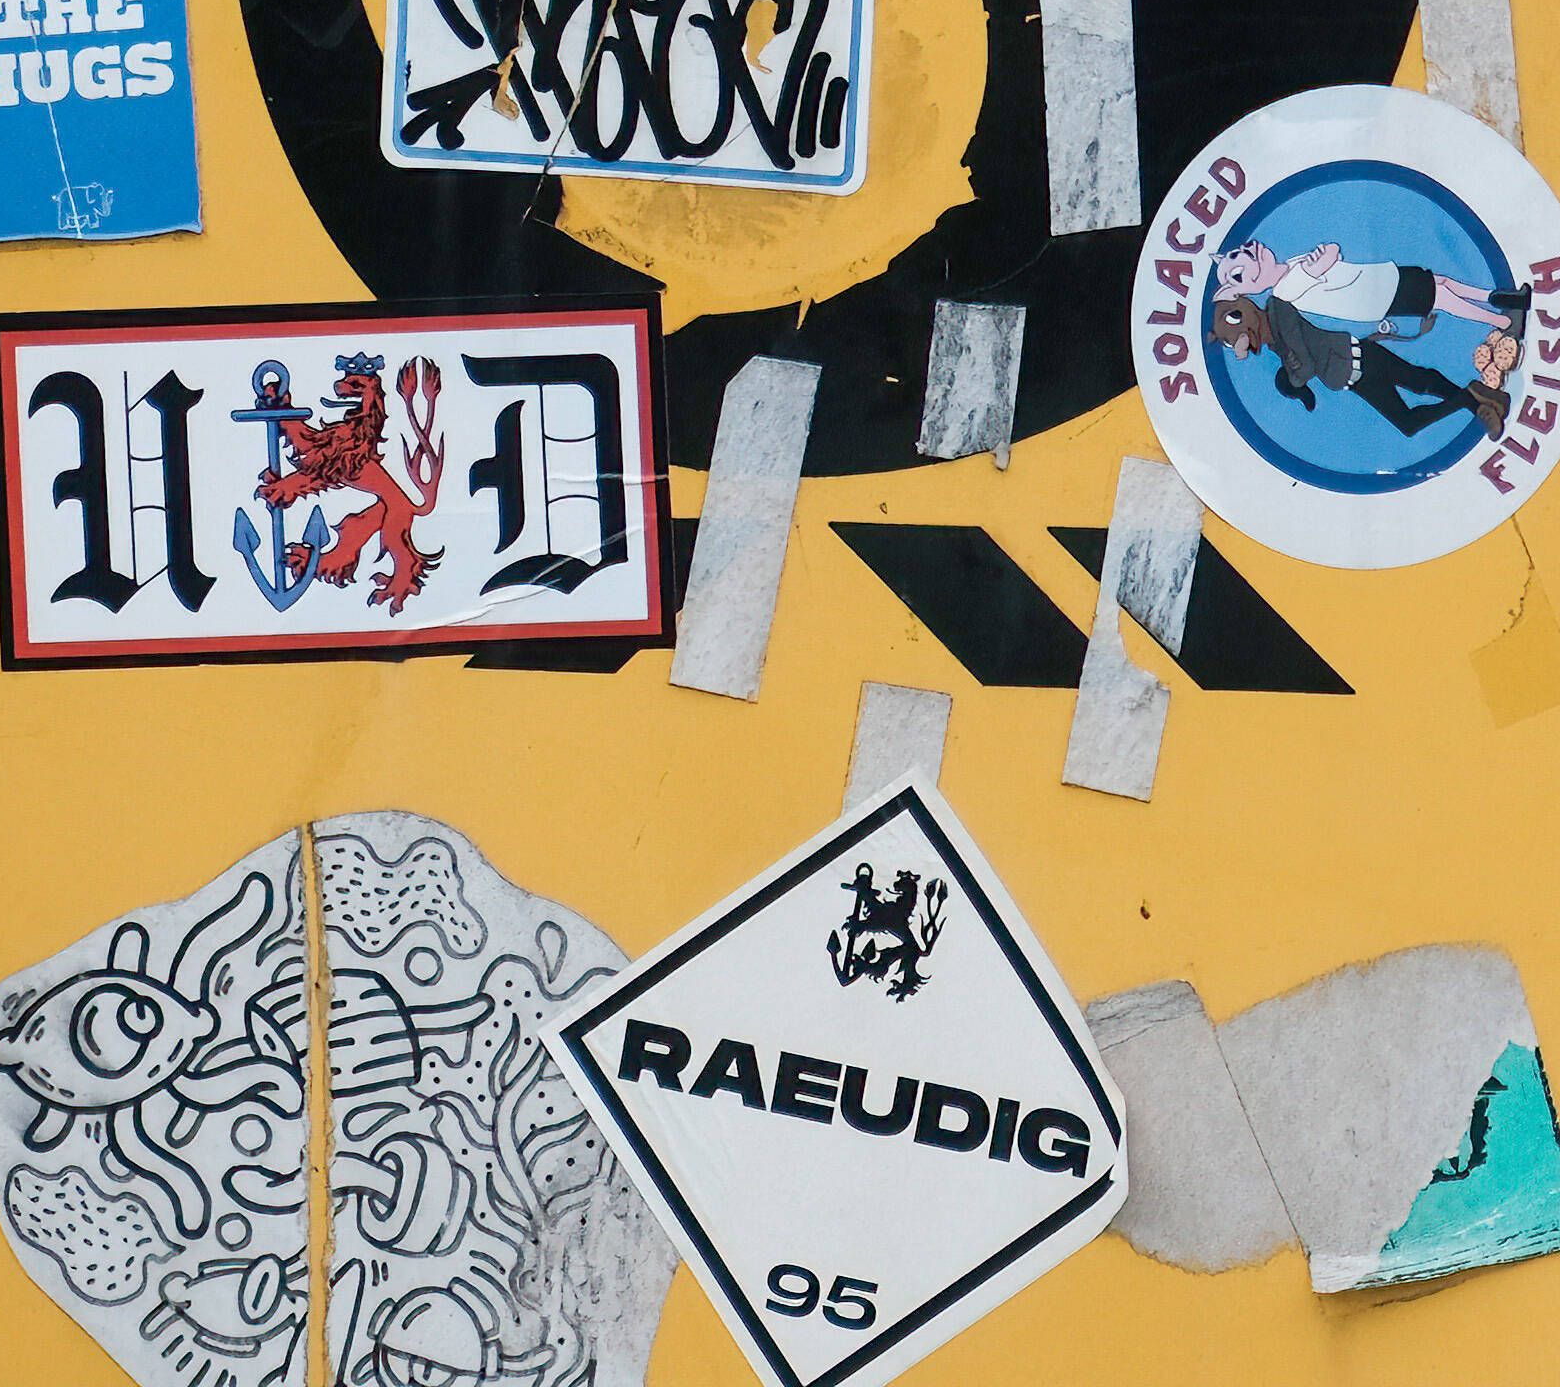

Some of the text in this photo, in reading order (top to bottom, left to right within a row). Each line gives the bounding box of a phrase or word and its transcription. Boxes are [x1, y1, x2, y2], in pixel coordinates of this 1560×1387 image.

[1147, 156, 1247, 405] SOLACED
[461, 353, 629, 598] D
[617, 1018, 1093, 1178] RAEUDIG
[765, 1263, 879, 1331] 95
